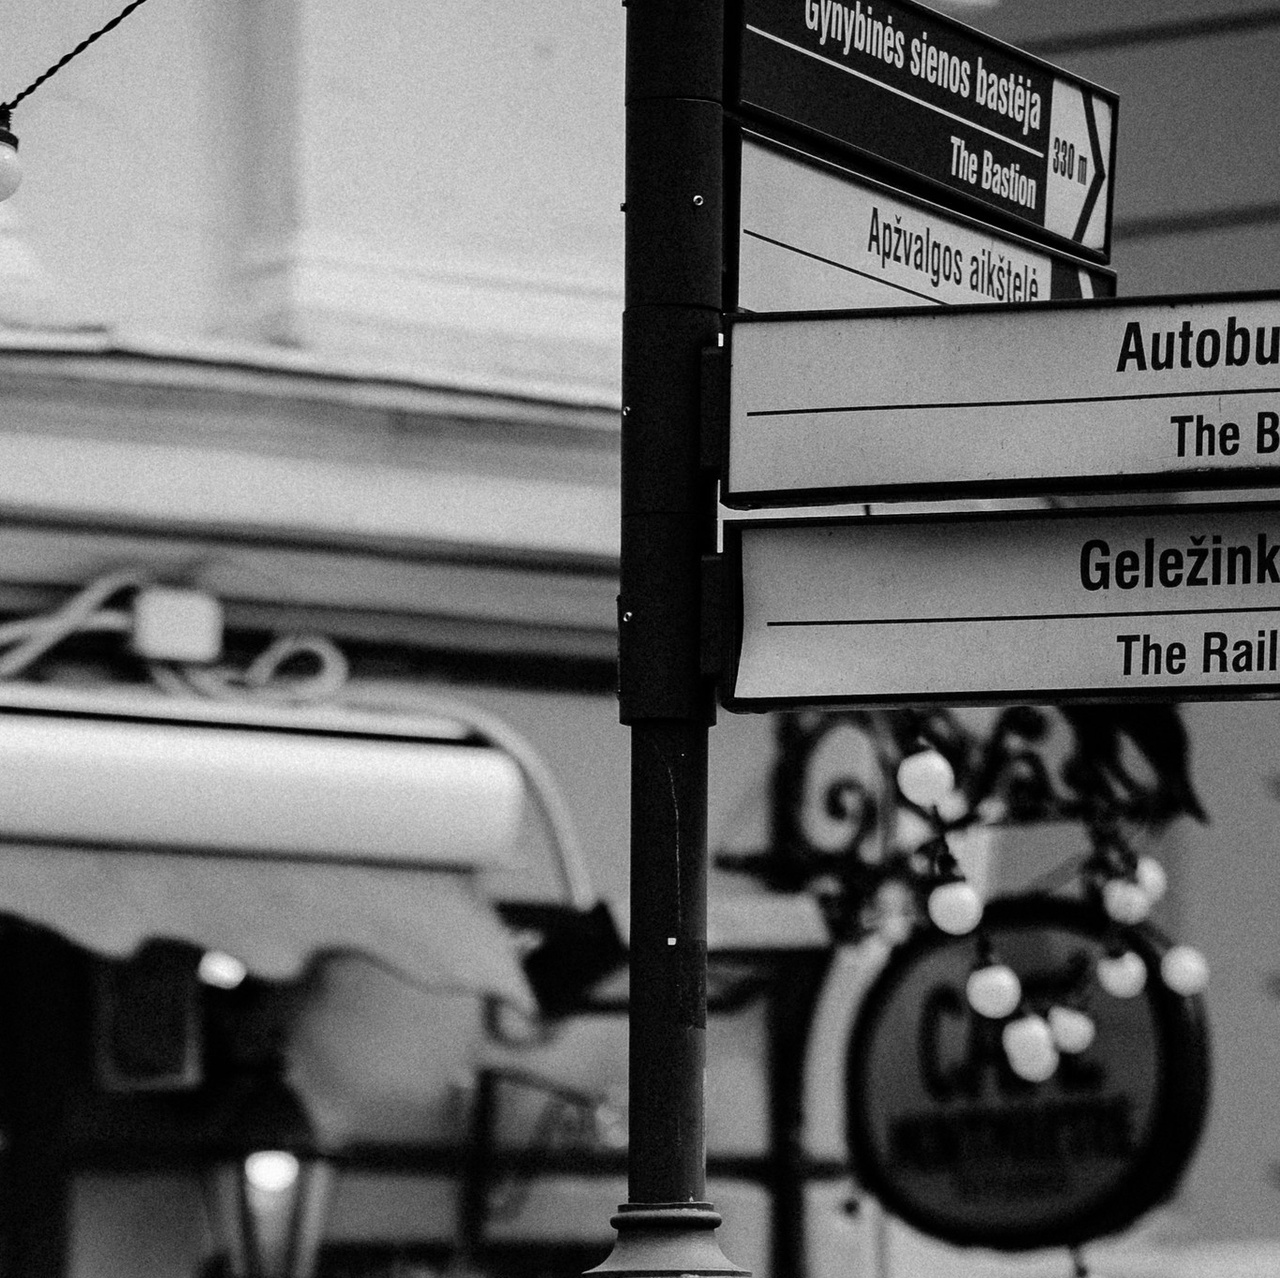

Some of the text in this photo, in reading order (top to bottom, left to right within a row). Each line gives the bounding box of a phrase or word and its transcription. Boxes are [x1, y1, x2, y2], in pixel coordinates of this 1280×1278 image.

[805, 0, 1041, 136] Gynybinės sienos bastėja
[950, 135, 1036, 210] The Bastion
[1053, 136, 1087, 186] 330 m
[868, 206, 963, 288] Apžvalgos
[1116, 316, 1280, 372] Autobu
[1170, 411, 1280, 457] The B
[1080, 533, 1280, 591] Geležink
[1117, 629, 1278, 676] The Rail
